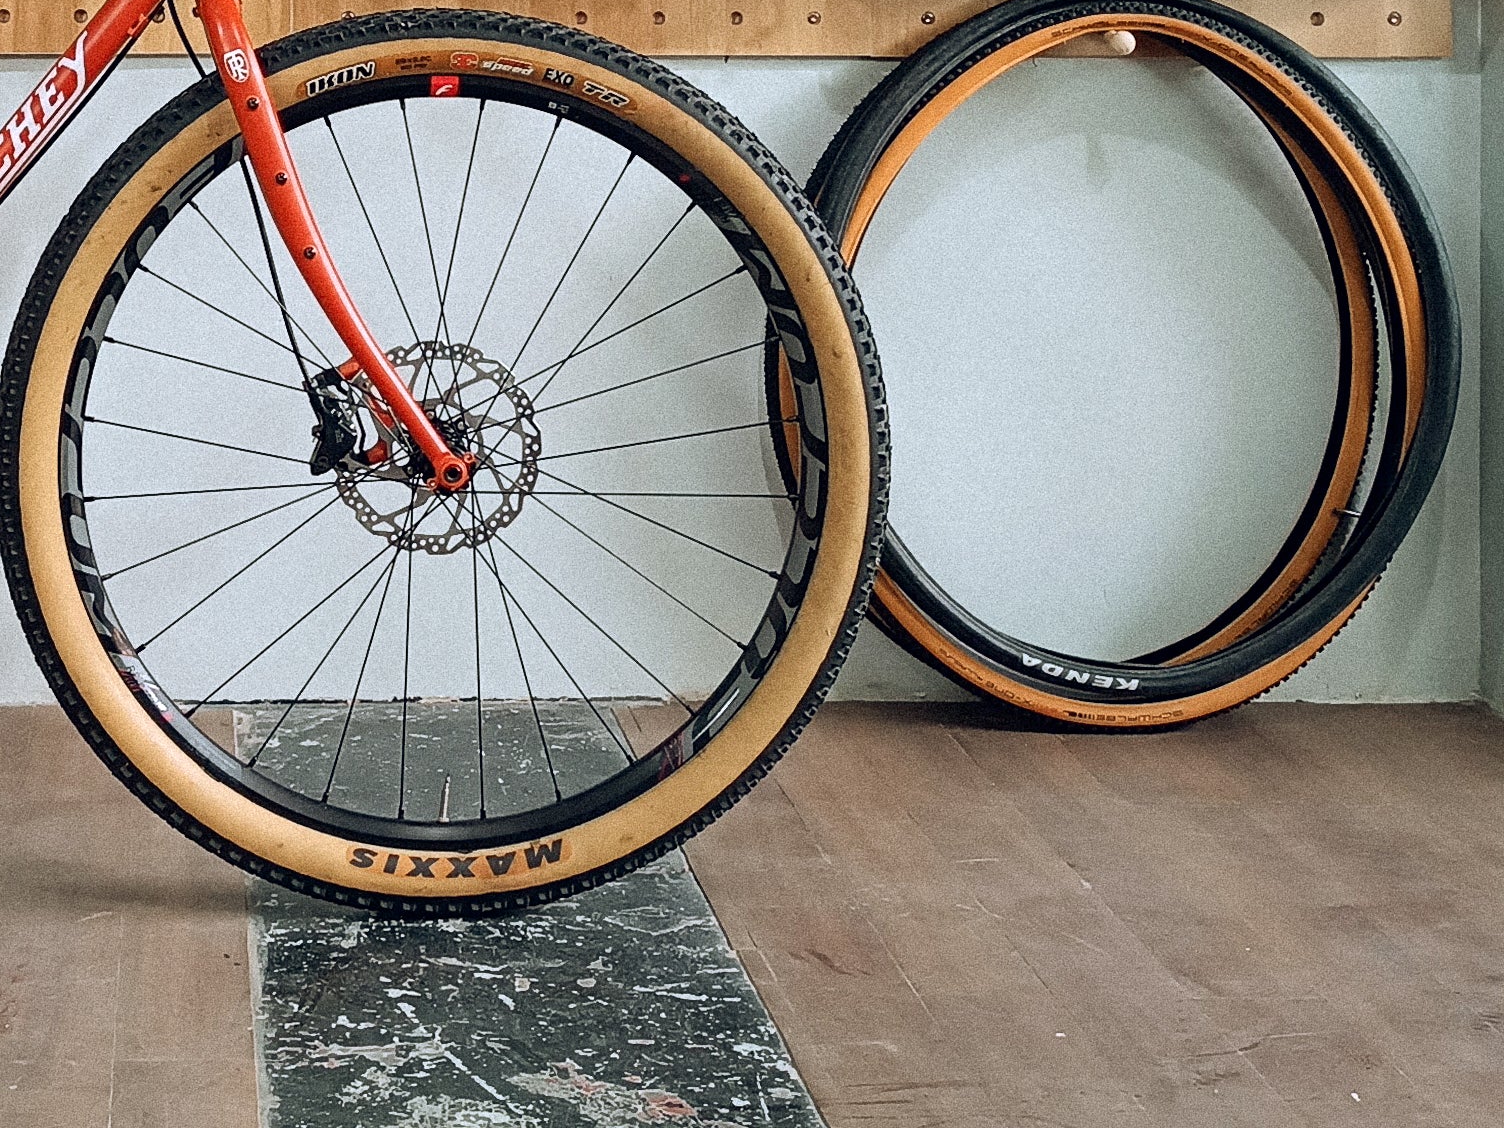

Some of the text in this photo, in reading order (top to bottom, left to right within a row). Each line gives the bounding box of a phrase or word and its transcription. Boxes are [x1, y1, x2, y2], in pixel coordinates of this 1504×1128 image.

[305, 62, 376, 97] IKON
[481, 60, 534, 76] speed
[543, 68, 575, 87] EXO
[582, 79, 630, 109] TR
[1021, 652, 1141, 691] KENDA
[349, 838, 563, 879] MAXXIS
